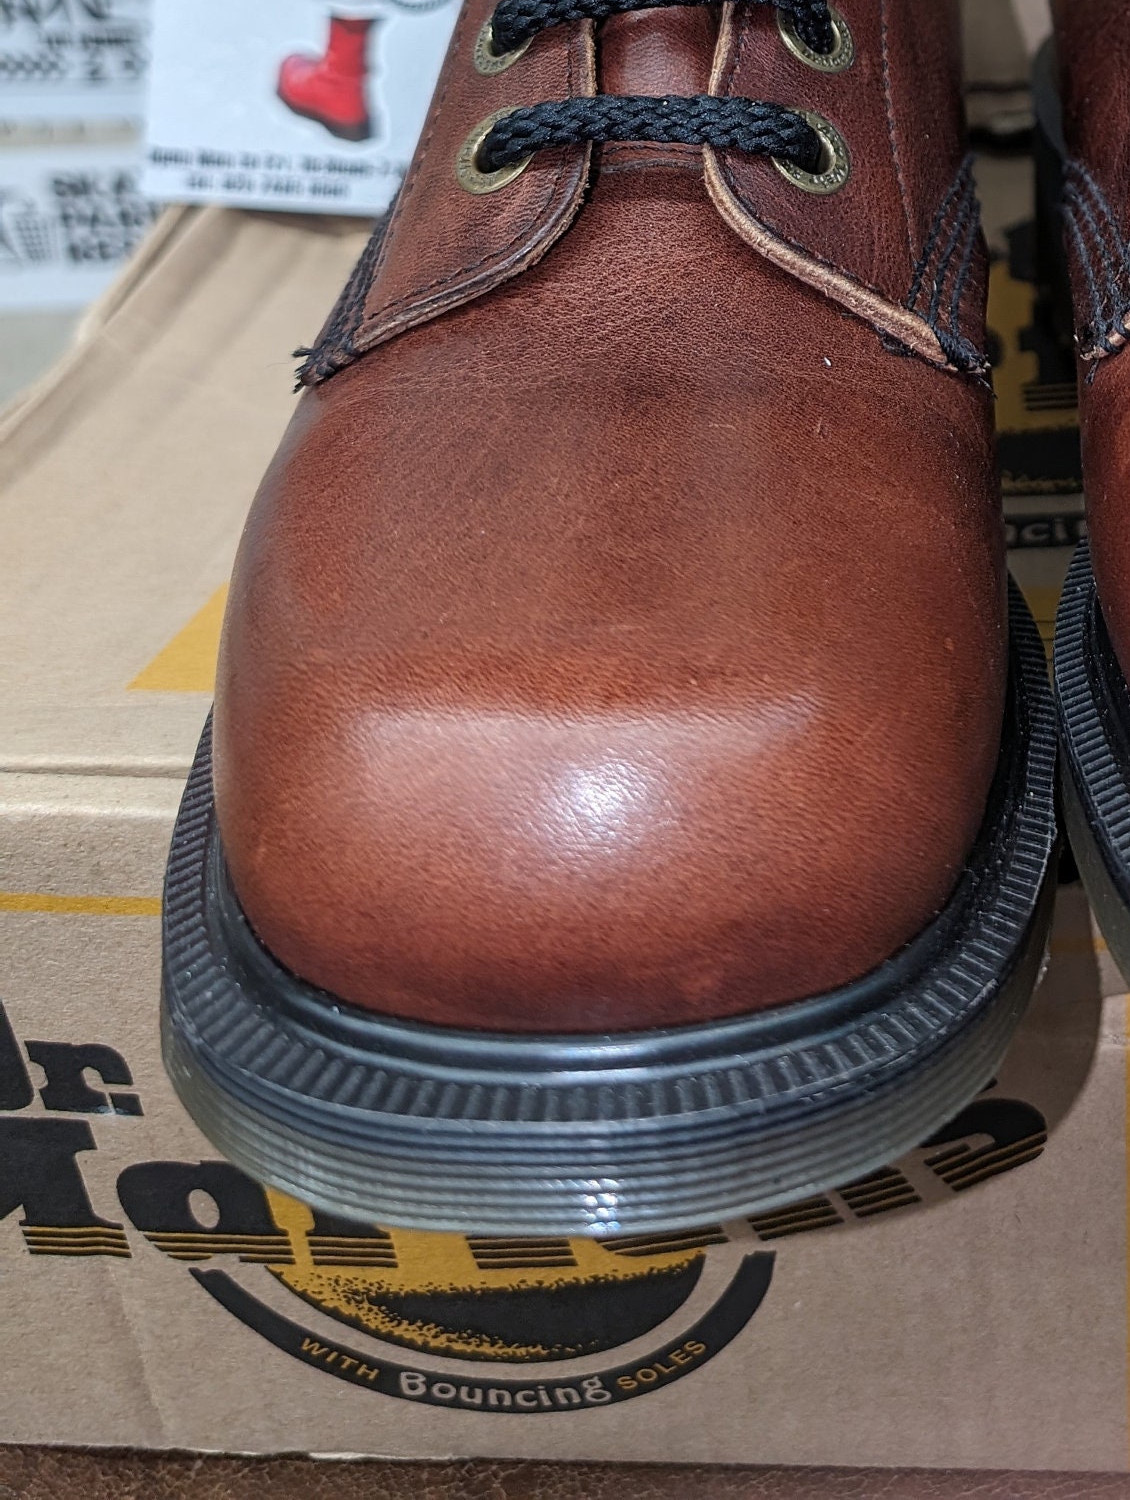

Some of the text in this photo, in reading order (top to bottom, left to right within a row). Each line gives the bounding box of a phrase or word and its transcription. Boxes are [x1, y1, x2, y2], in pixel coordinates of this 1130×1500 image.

[300, 1336, 707, 1409] WITH Bouncing SOLES
